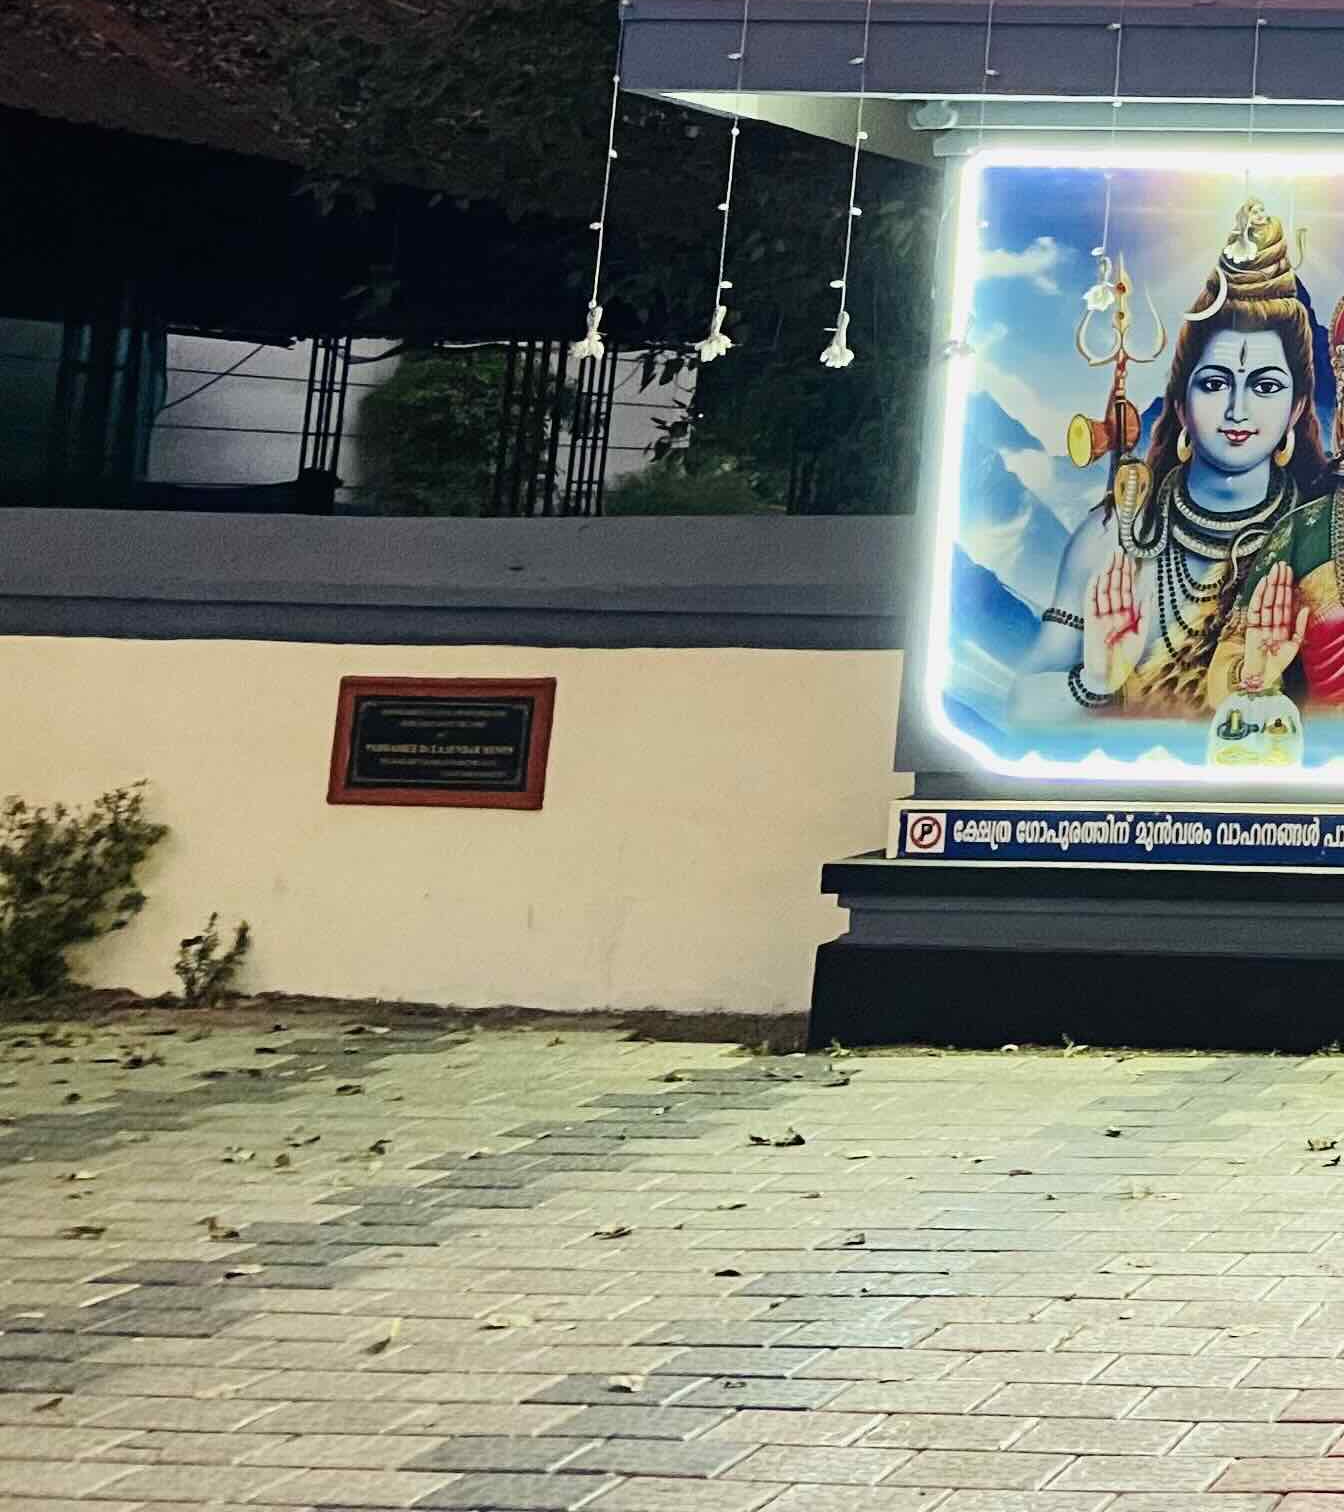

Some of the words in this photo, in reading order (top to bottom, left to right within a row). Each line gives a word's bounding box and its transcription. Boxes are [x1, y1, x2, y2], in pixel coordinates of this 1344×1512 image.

[953, 818, 1013, 850] ക്ഷേത്ര
[1016, 813, 1134, 851] ഗോപുരത്തിന്
[1135, 814, 1211, 852] മുൻവശം
[1216, 817, 1320, 850] വാഹനങ്ങൾ
